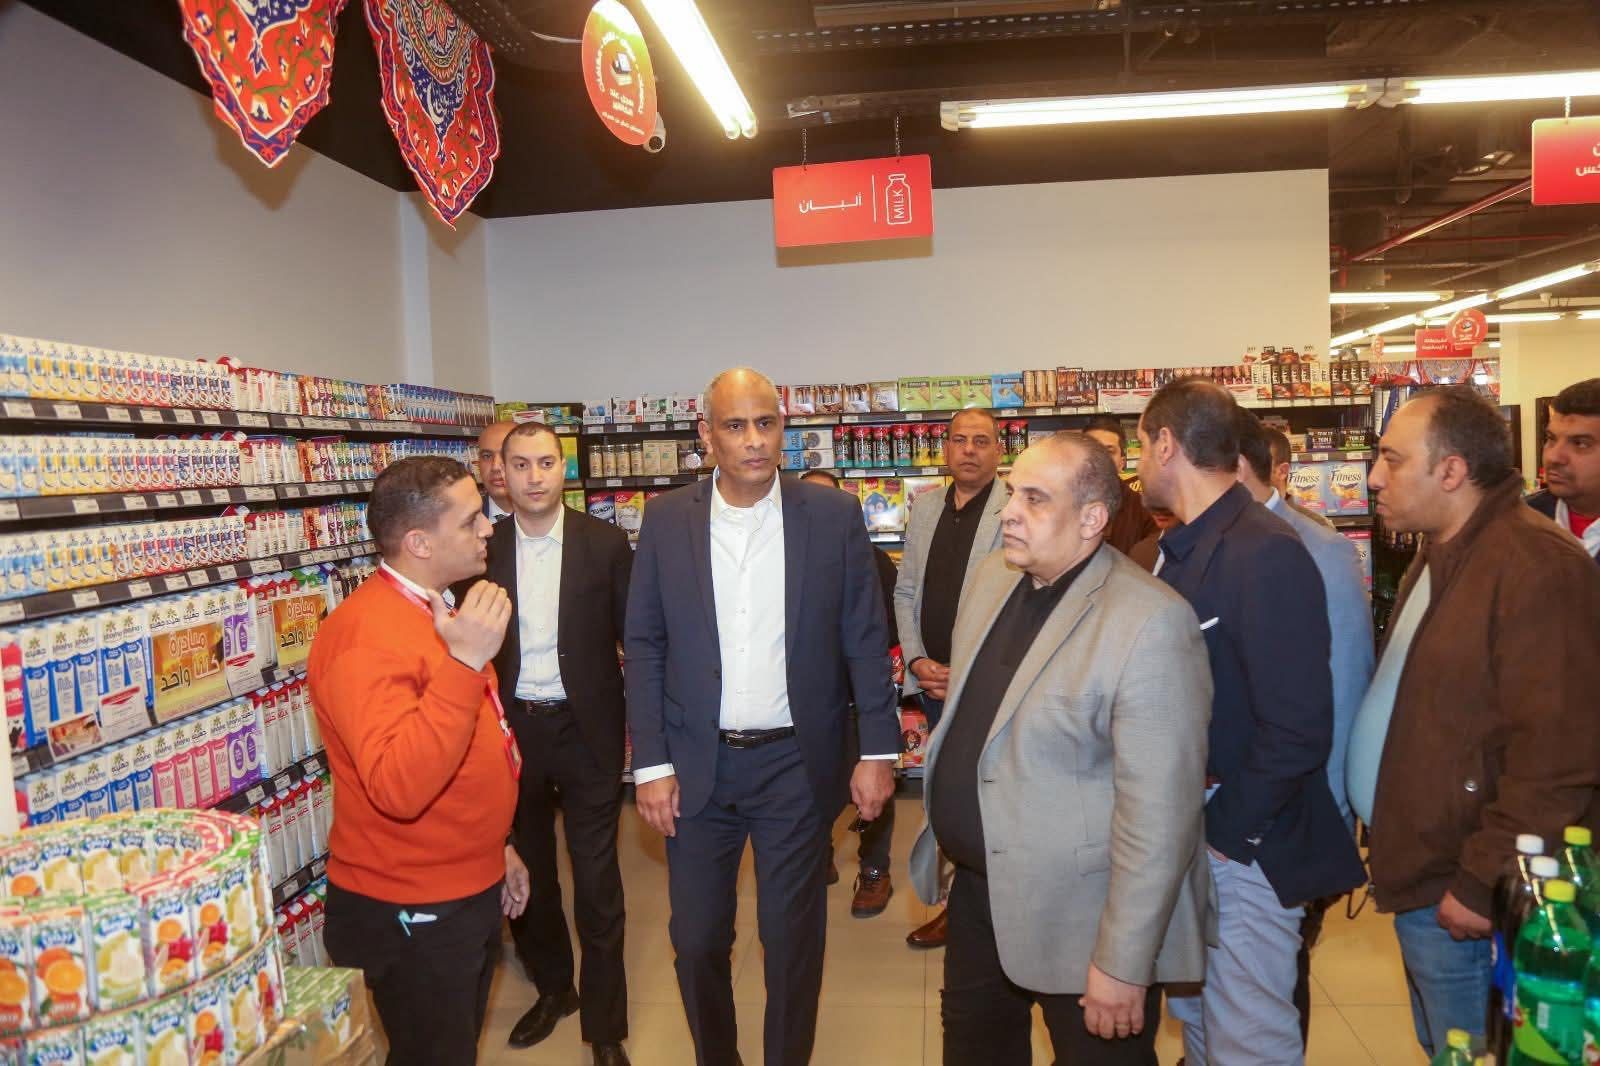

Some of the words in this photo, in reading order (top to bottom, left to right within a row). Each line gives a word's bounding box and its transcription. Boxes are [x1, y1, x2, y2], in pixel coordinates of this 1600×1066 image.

[893, 188, 905, 218] MILK
[1289, 471, 1320, 483] Fitness
[1331, 469, 1362, 482] Fitness
[169, 627, 208, 657] مبادرة
[160, 664, 191, 692] واحد
